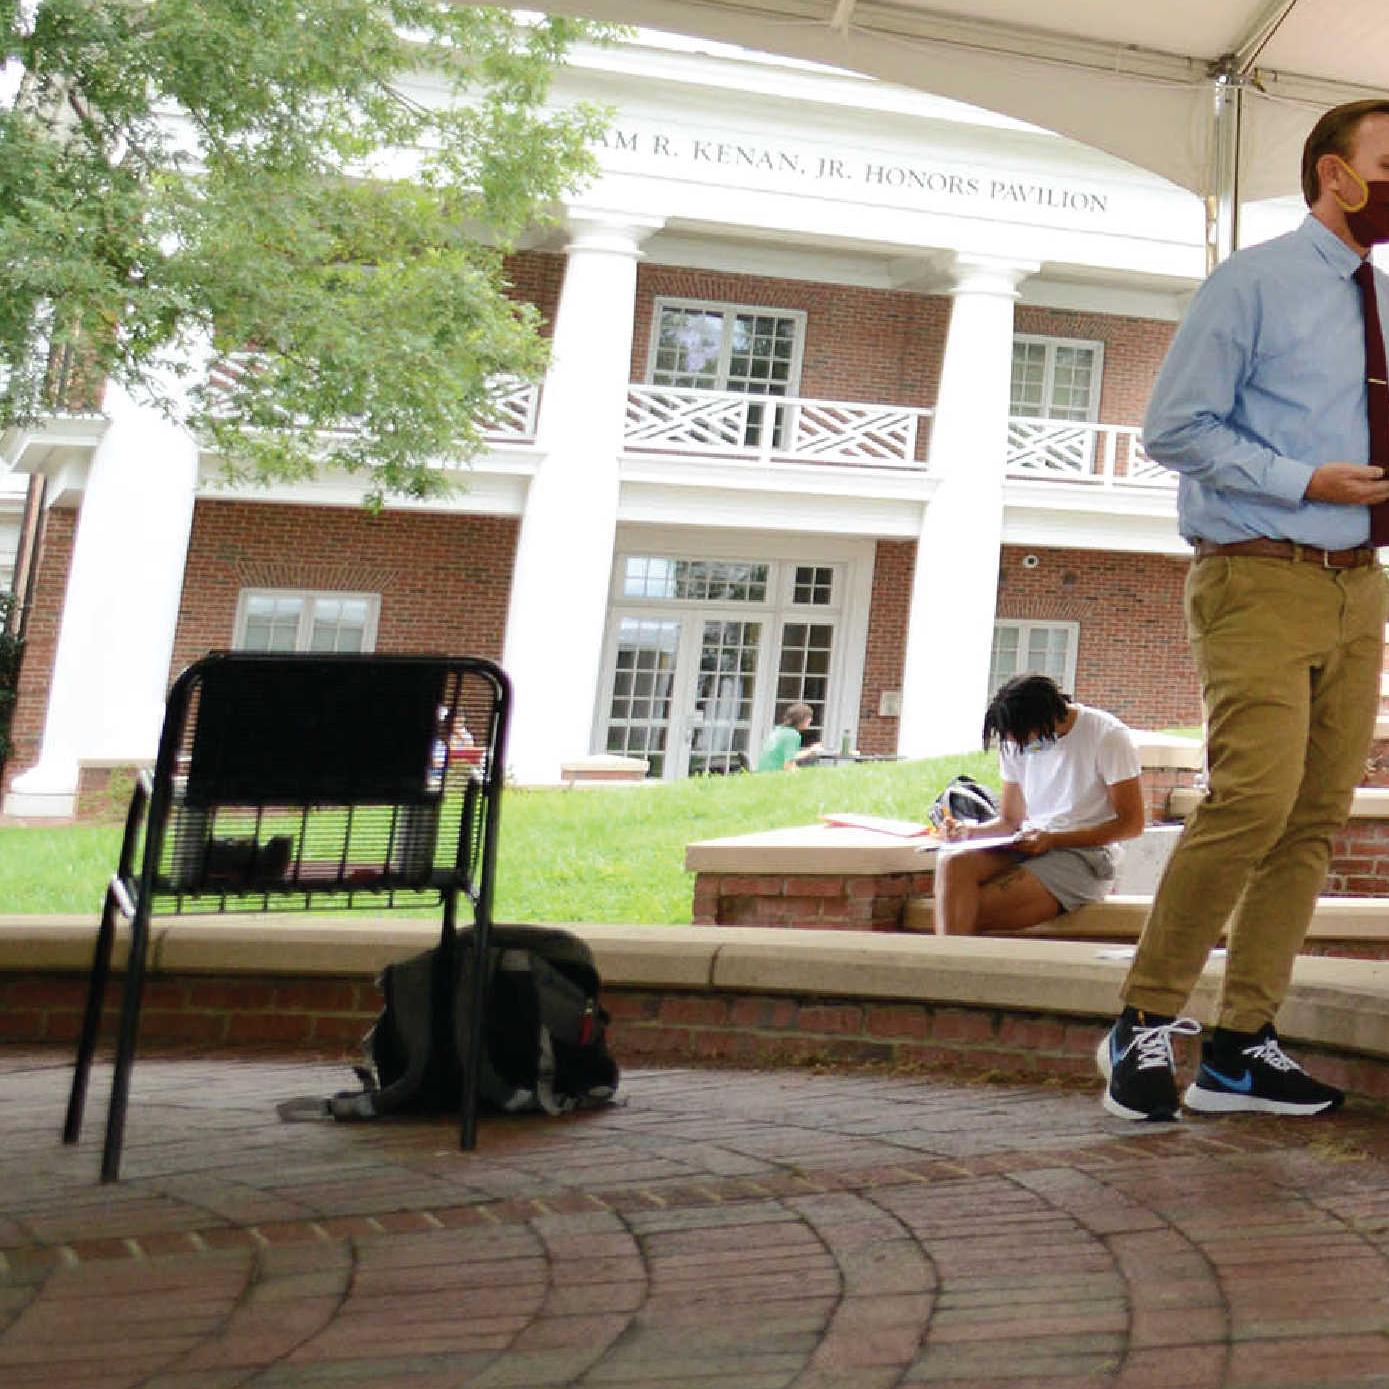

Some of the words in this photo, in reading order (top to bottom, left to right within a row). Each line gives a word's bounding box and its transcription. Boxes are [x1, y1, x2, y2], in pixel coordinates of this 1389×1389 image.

[653, 134, 678, 158] R.
[814, 157, 852, 180] JR.
[865, 164, 978, 195] HONORS
[990, 179, 1108, 213] PAVILION
